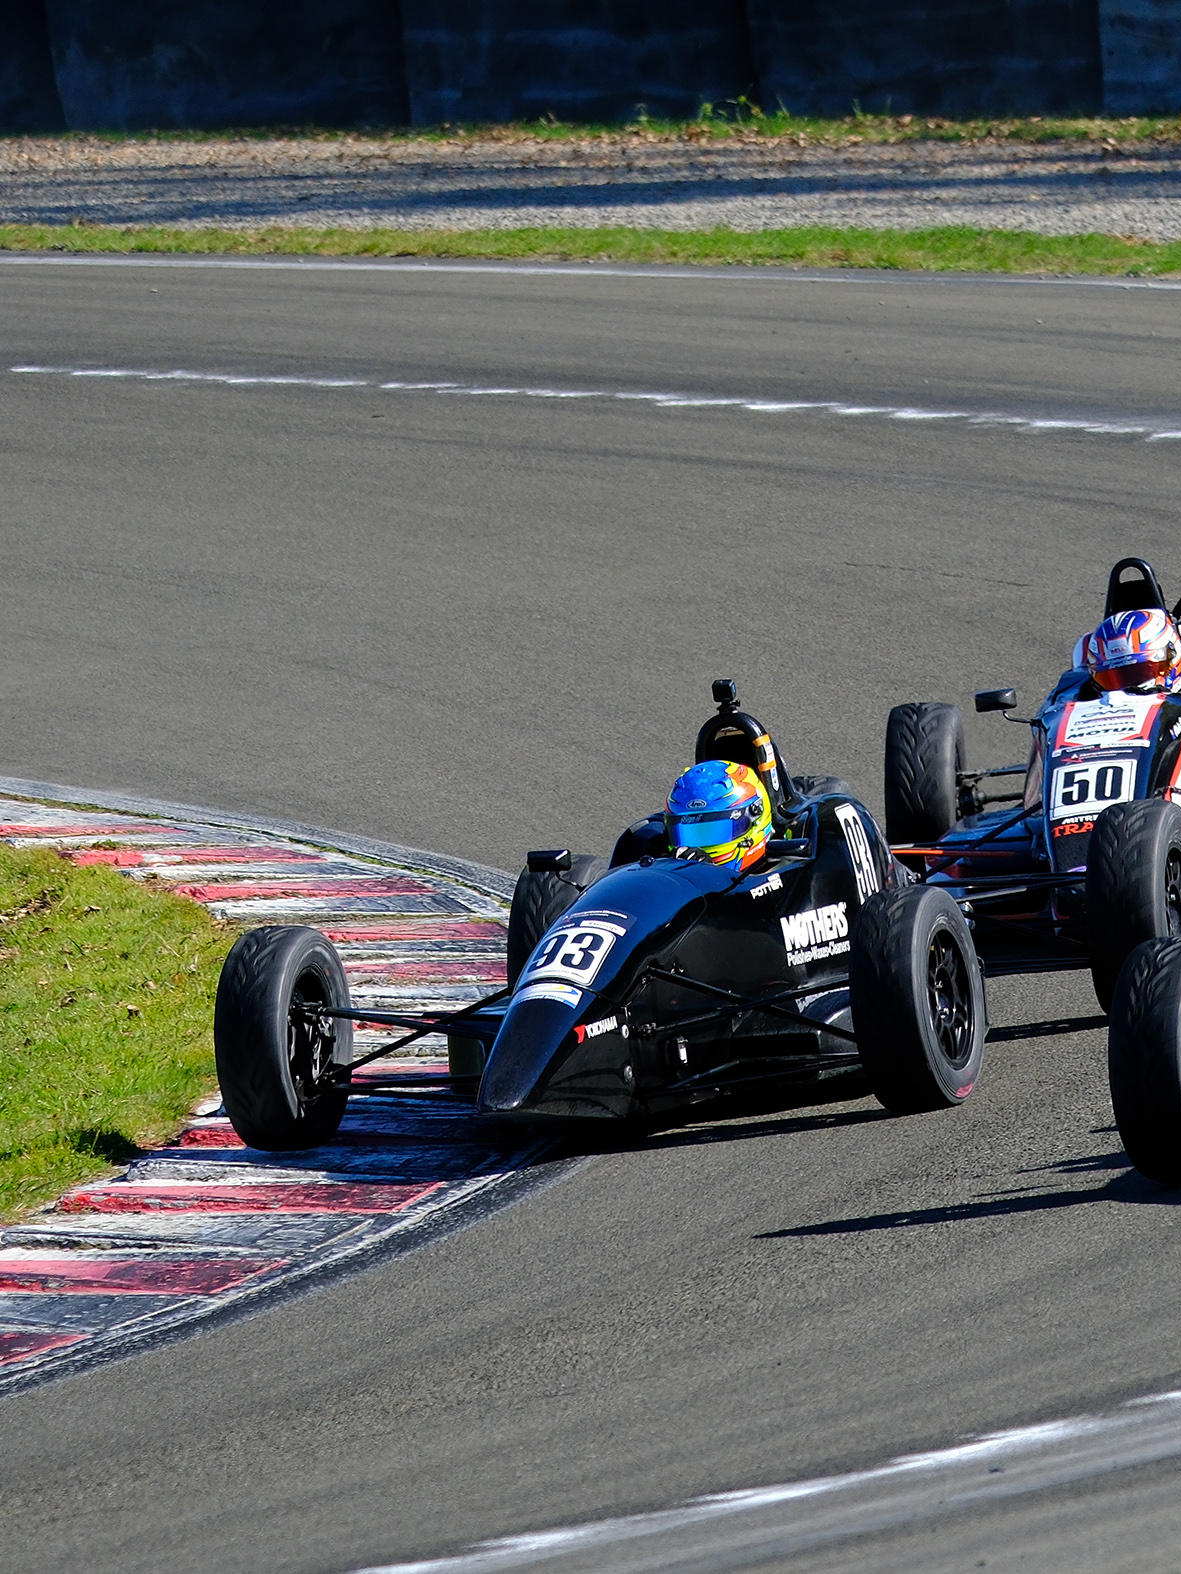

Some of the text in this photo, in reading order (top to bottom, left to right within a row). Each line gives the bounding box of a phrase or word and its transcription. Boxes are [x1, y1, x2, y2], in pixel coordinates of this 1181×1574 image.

[1066, 726, 1137, 740] MOTUL
[1061, 765, 1124, 806] 50
[750, 878, 783, 899] POTTER
[780, 901, 849, 952] MOTHERS
[526, 932, 605, 974] 93
[585, 1015, 618, 1039] YOKOHAMA
